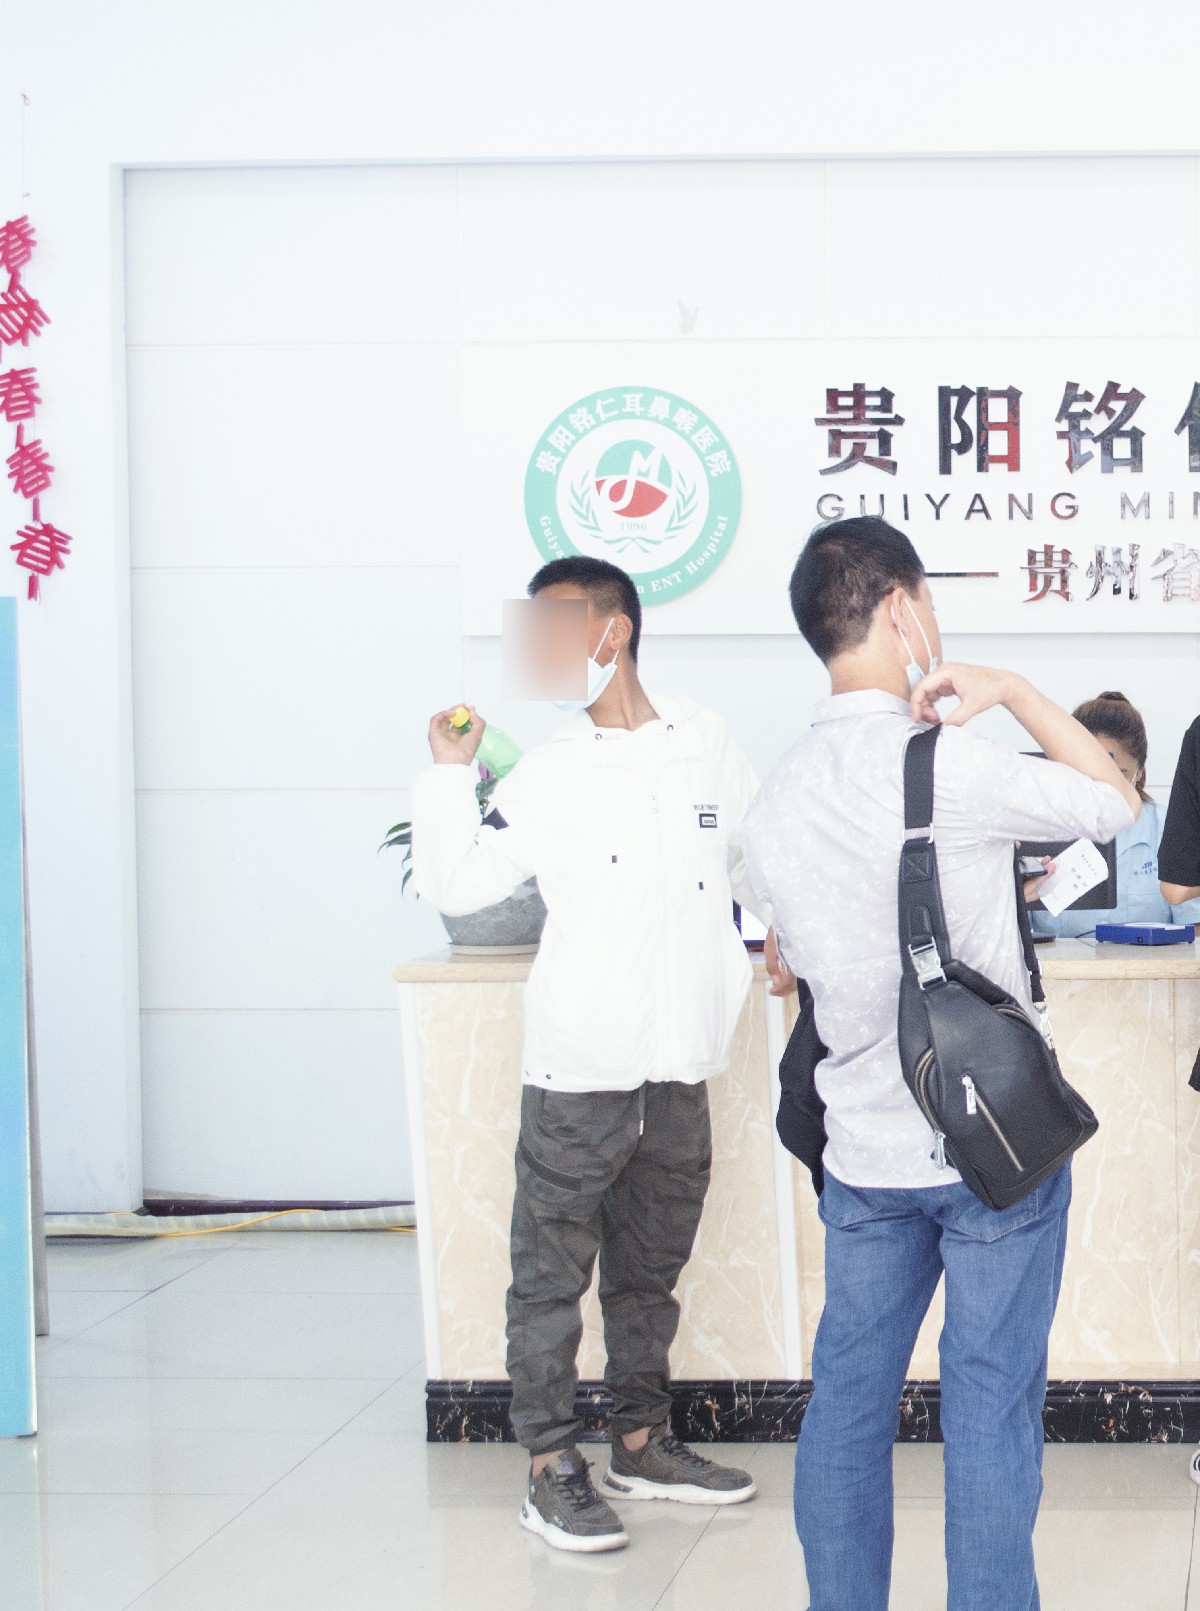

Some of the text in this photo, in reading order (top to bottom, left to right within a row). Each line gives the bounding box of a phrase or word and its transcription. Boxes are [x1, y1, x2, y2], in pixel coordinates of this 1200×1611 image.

[535, 393, 732, 478] 贵阳铭仁耳鼻喉医院
[816, 493, 1080, 521] GUIYANG
[651, 571, 682, 593] ENT
[685, 515, 729, 575] Hospital
